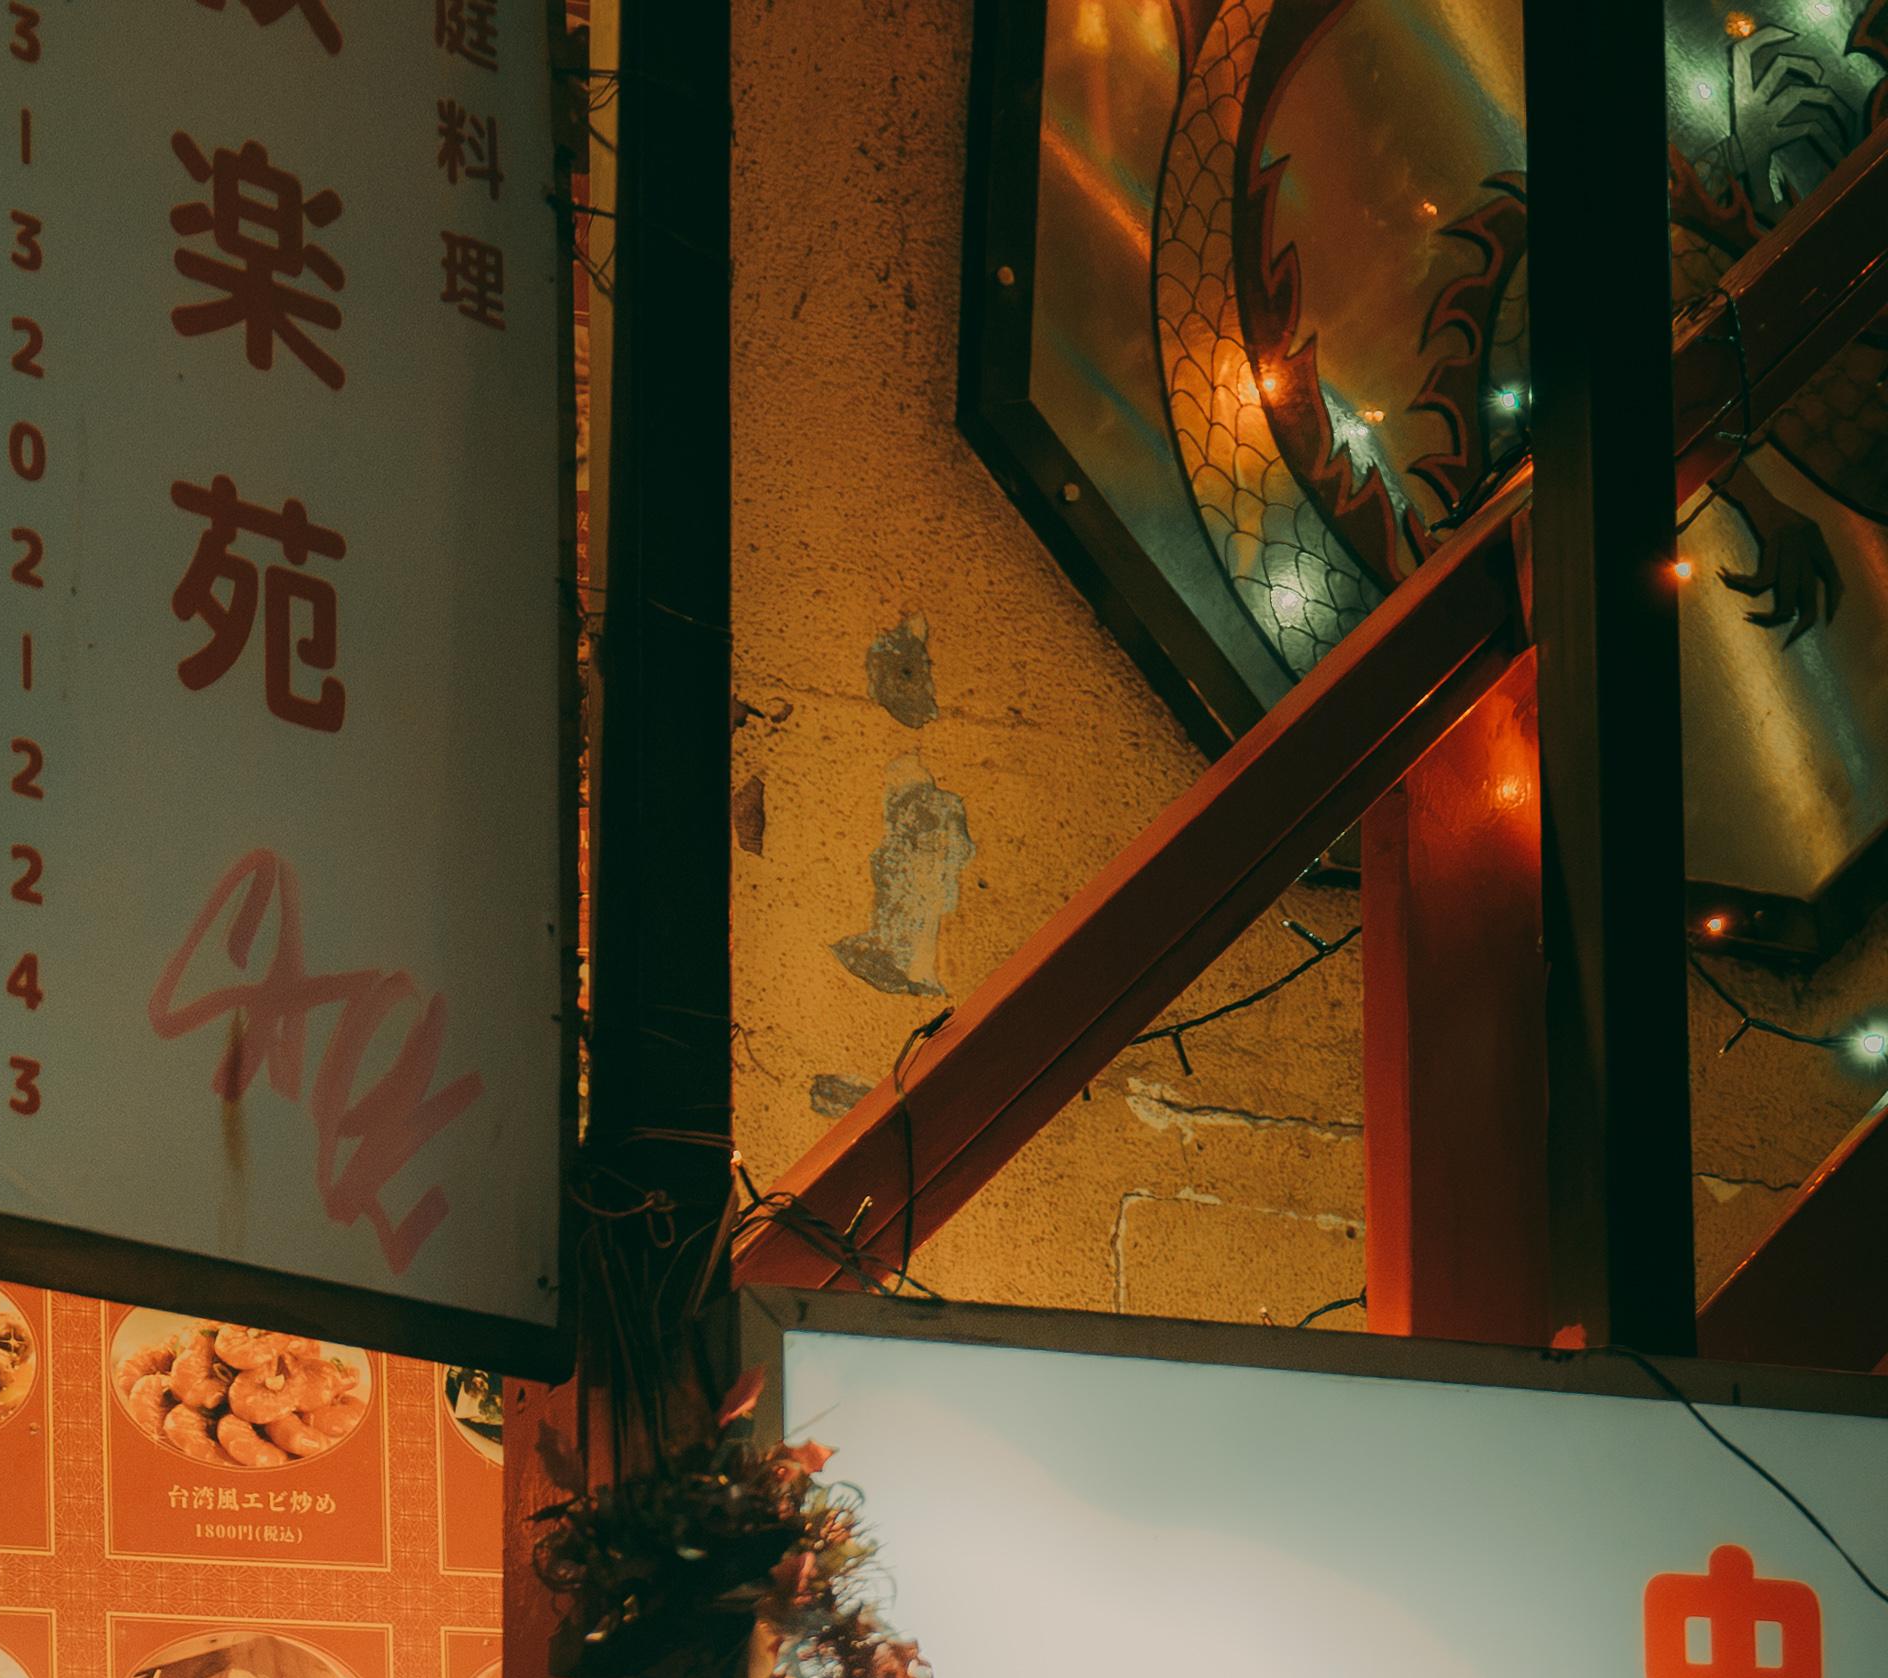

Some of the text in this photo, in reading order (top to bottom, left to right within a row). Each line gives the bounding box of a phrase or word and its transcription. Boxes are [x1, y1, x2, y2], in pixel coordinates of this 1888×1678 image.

[169, 0, 347, 733] 楽苑
[167, 1484, 337, 1514] 台湾風エビ炒め
